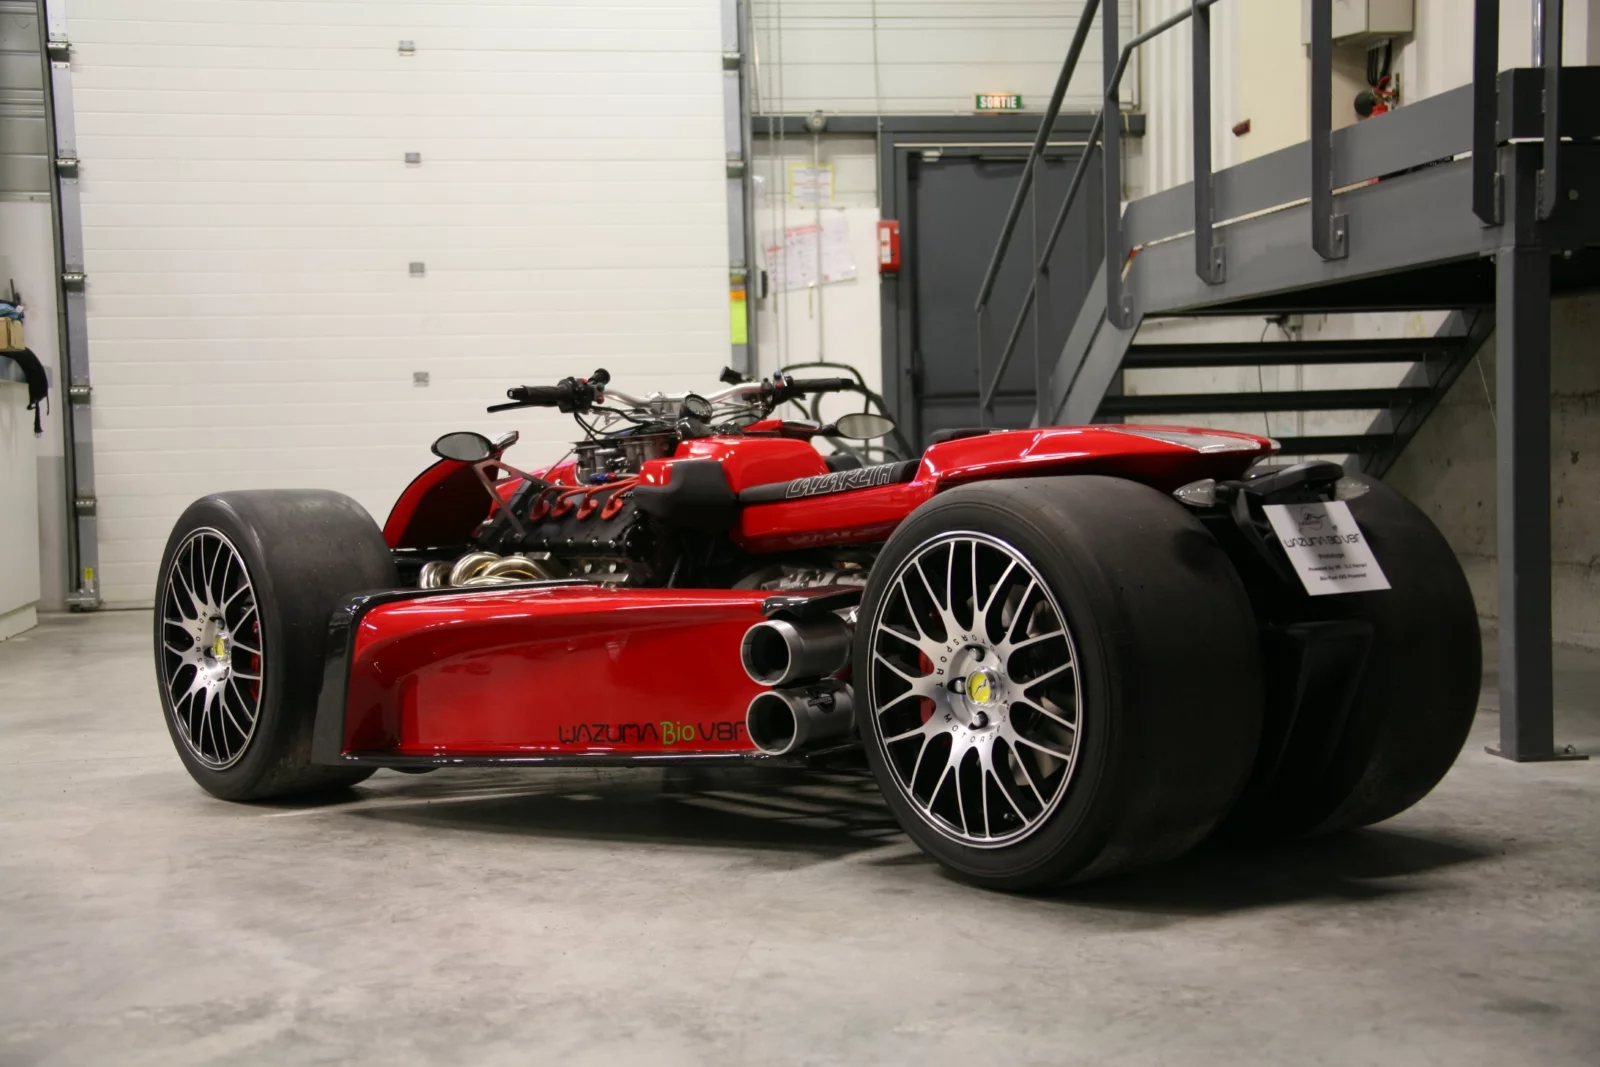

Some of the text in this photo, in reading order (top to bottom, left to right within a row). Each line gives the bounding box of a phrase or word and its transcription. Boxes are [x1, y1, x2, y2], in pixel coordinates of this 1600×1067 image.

[980, 95, 1017, 109] SORTIE
[558, 723, 658, 743] WAZUMA
[660, 721, 696, 745] Bio
